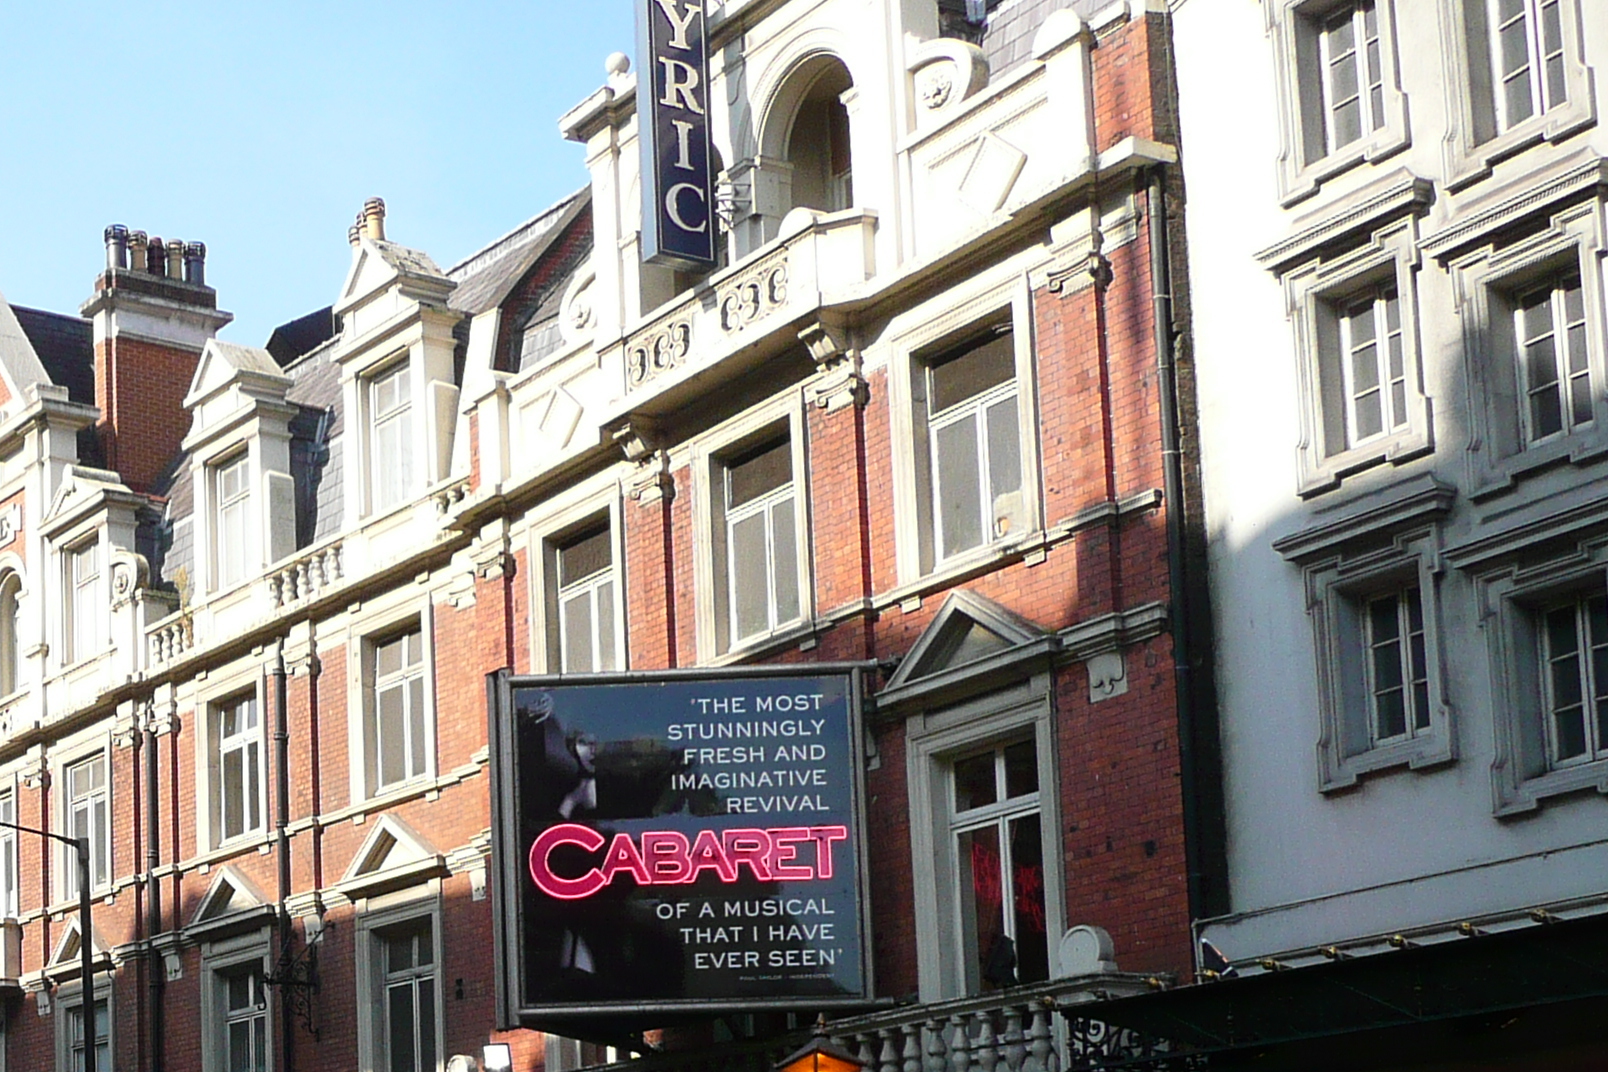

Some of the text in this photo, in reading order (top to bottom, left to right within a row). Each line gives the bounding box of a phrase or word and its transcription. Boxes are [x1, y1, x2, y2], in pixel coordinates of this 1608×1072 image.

[755, 694, 825, 712] MOST
[667, 718, 826, 741] STUNNINGLY
[683, 745, 827, 766] FRESH AND
[671, 768, 828, 791] IMAGINATIVE
[726, 794, 830, 814] REVIVAL
[528, 822, 848, 900] CABARET
[656, 898, 836, 920] OF A MUSICAL
[680, 923, 836, 945] THAT I HAVE
[694, 950, 760, 970] EVER
